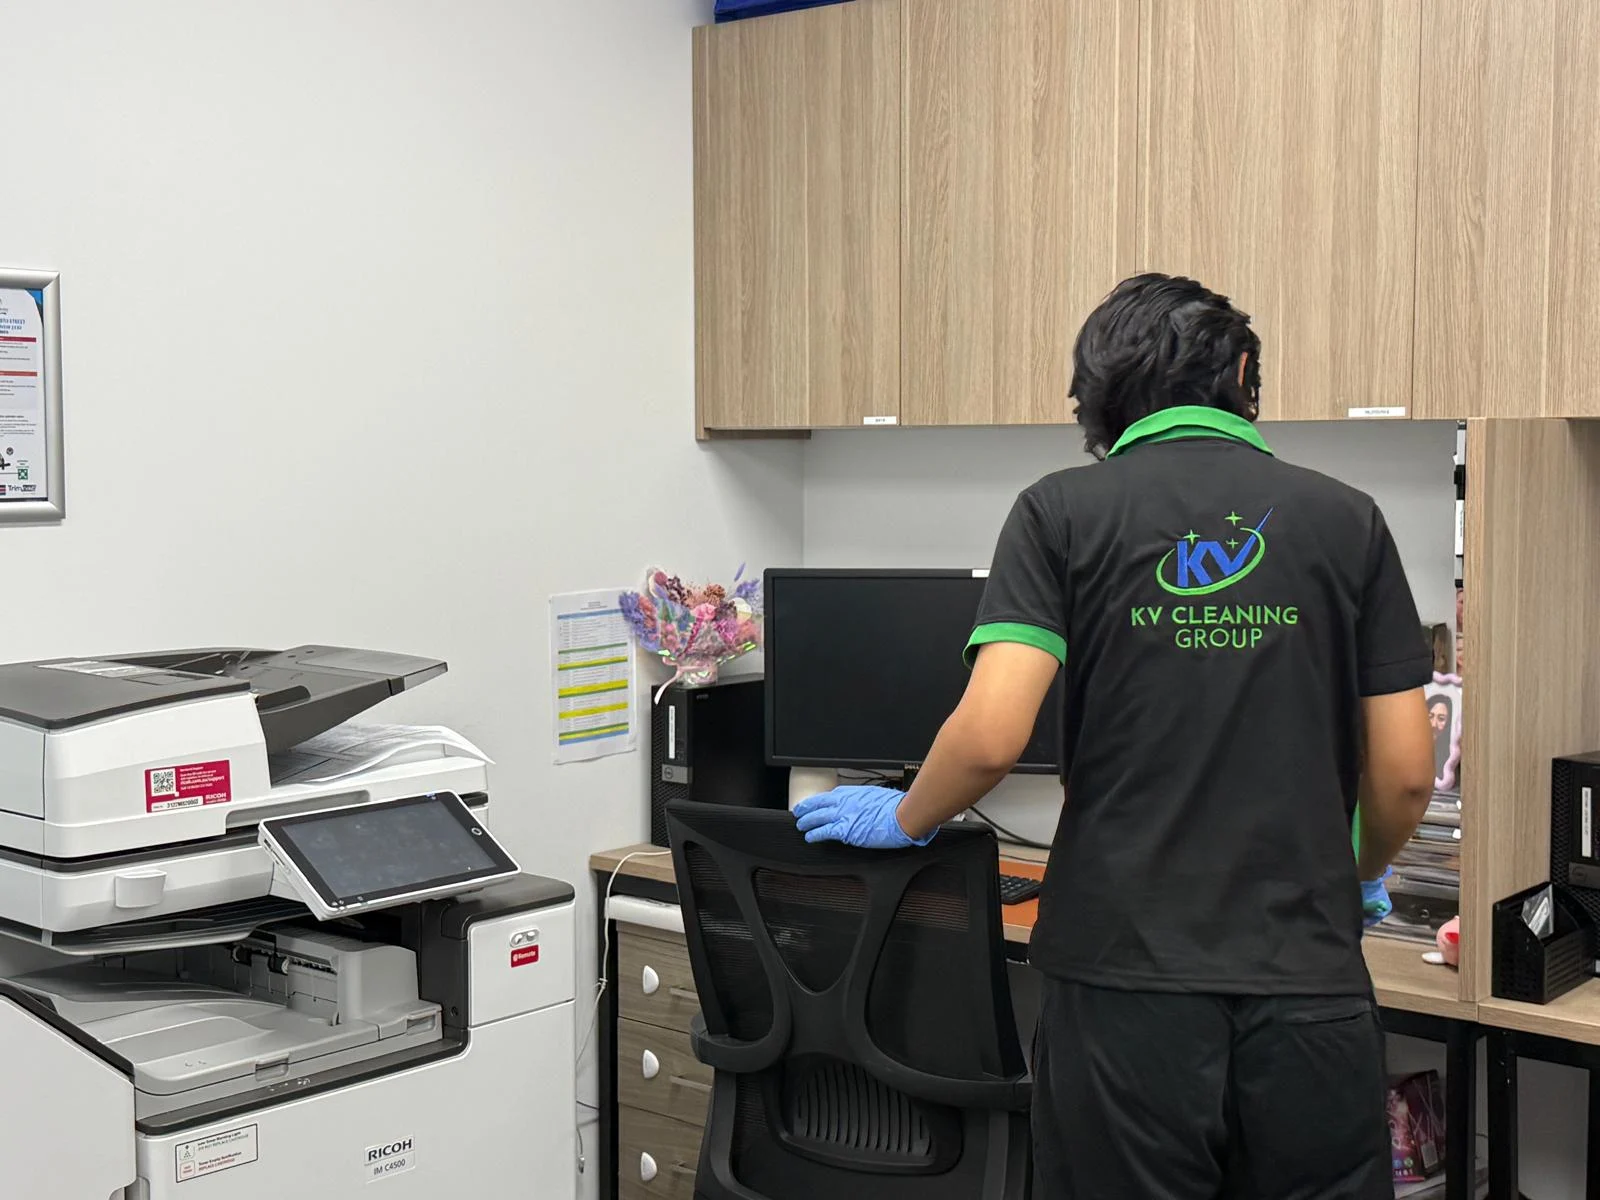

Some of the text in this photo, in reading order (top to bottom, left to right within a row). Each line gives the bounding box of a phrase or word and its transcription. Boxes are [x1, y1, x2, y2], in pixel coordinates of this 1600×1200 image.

[1177, 507, 1273, 587] KV
[1131, 605, 1298, 626] KV CLEANING
[1175, 628, 1263, 648] GROUP
[368, 1139, 412, 1161] RICOH
[374, 1159, 405, 1175] IM C4500
